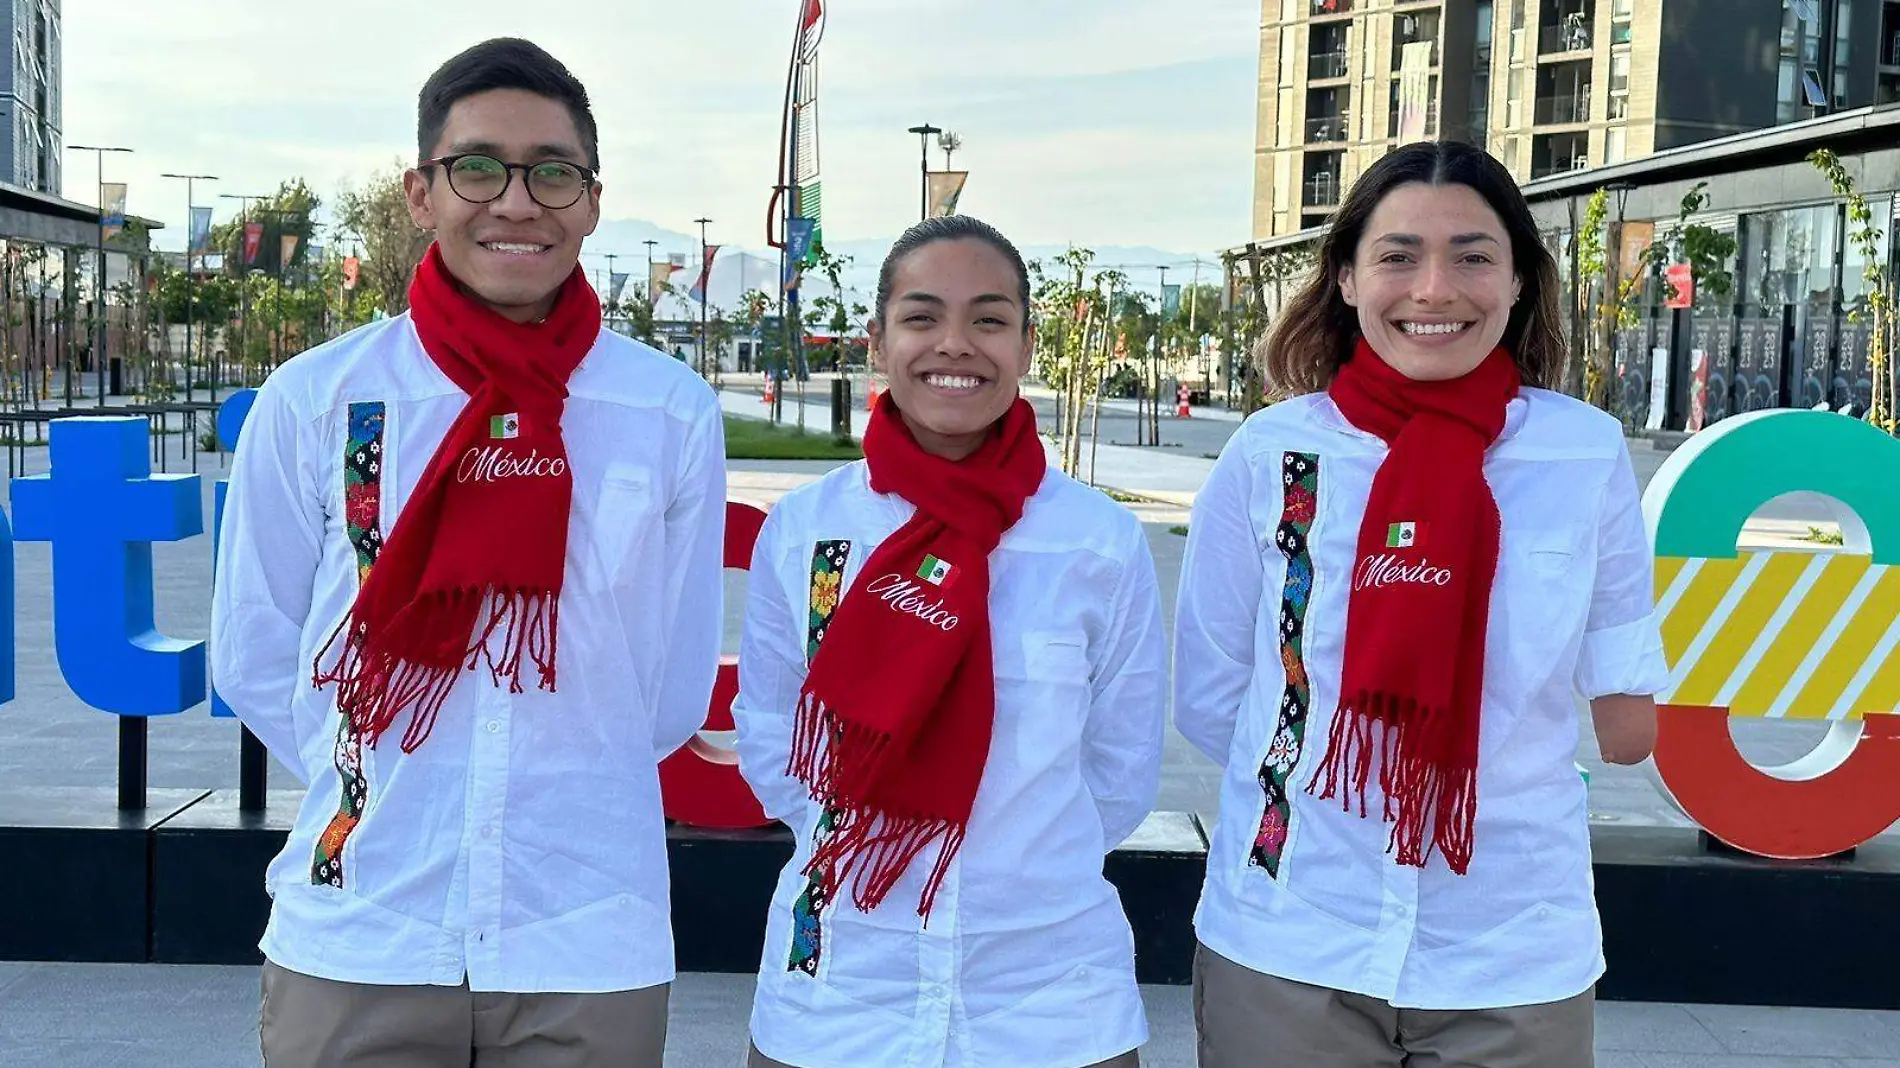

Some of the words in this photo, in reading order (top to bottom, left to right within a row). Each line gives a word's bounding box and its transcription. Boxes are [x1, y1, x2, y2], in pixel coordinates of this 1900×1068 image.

[457, 446, 565, 483] México
[1355, 553, 1451, 591] México
[867, 573, 958, 630] México
